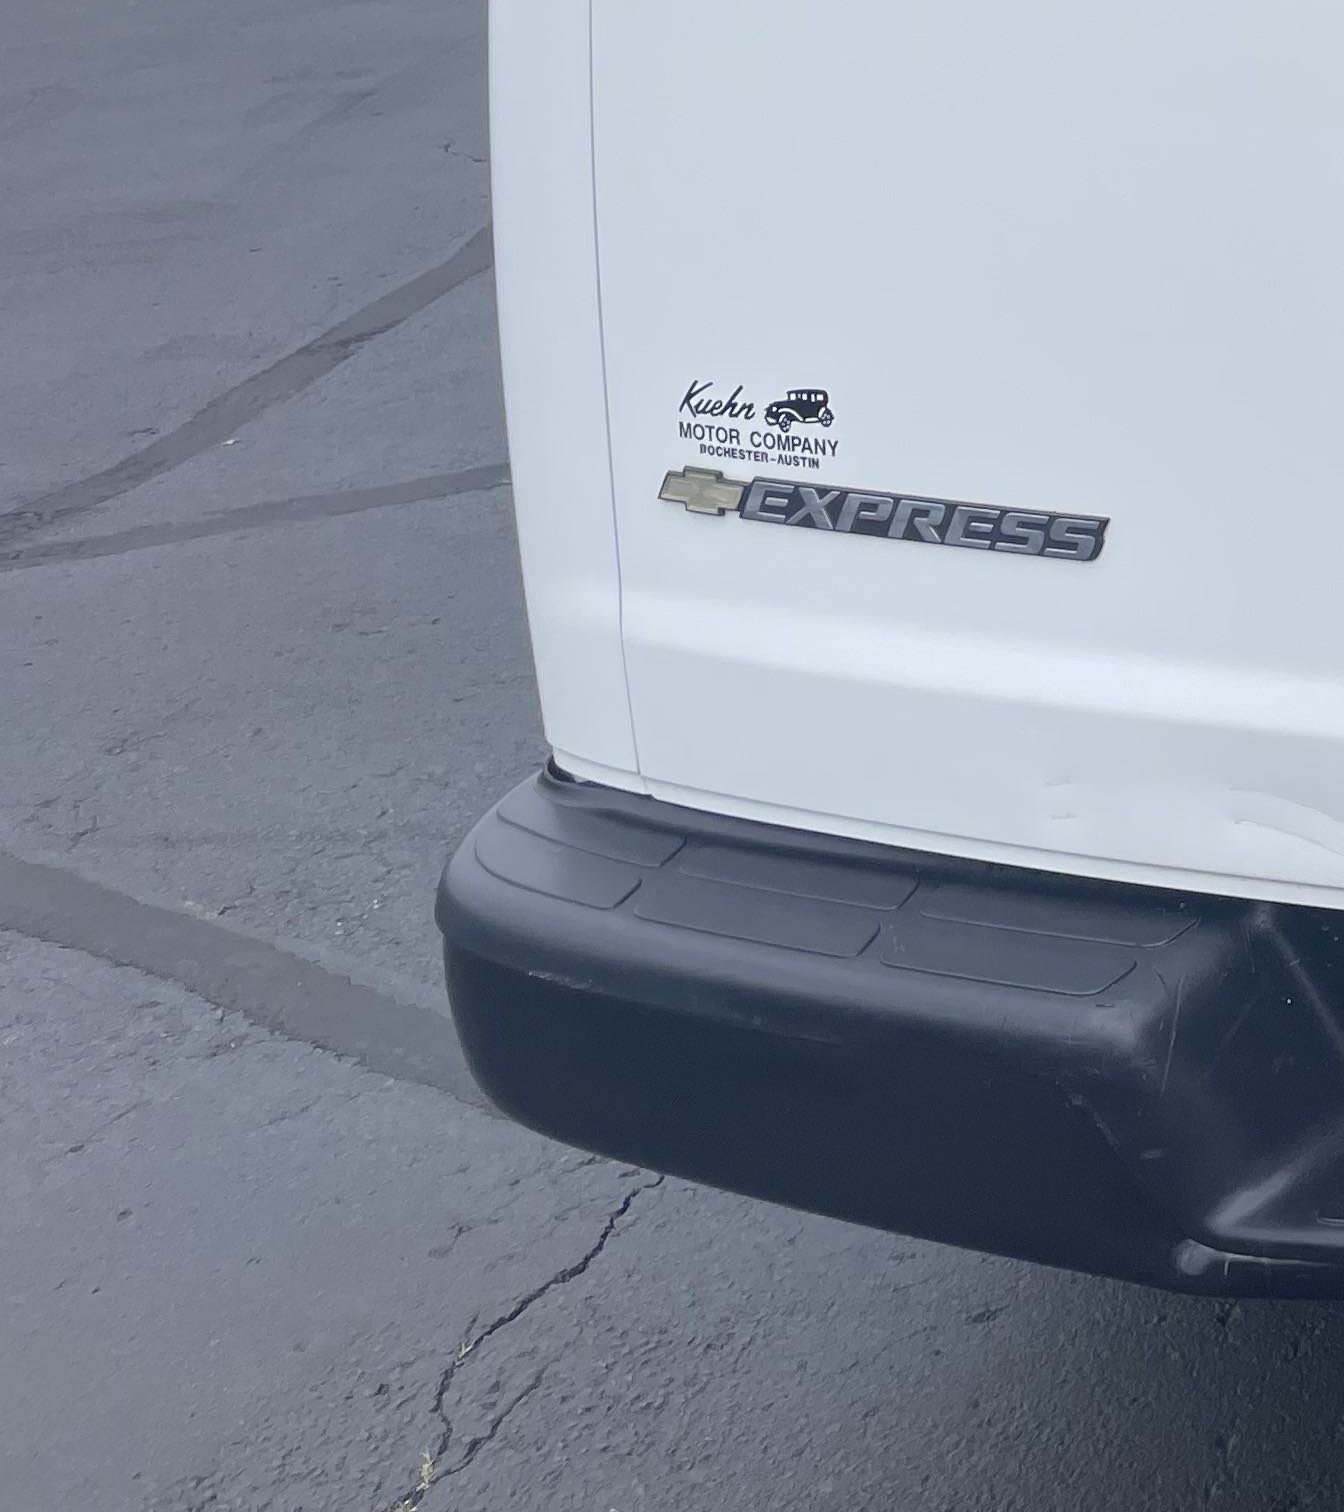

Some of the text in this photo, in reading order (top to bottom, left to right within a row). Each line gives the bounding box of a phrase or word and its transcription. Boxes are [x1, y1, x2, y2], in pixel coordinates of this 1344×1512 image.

[679, 380, 756, 420] Kuehn
[679, 422, 839, 457] MOTOR COMPANY
[745, 481, 1100, 561] EXPRESS
